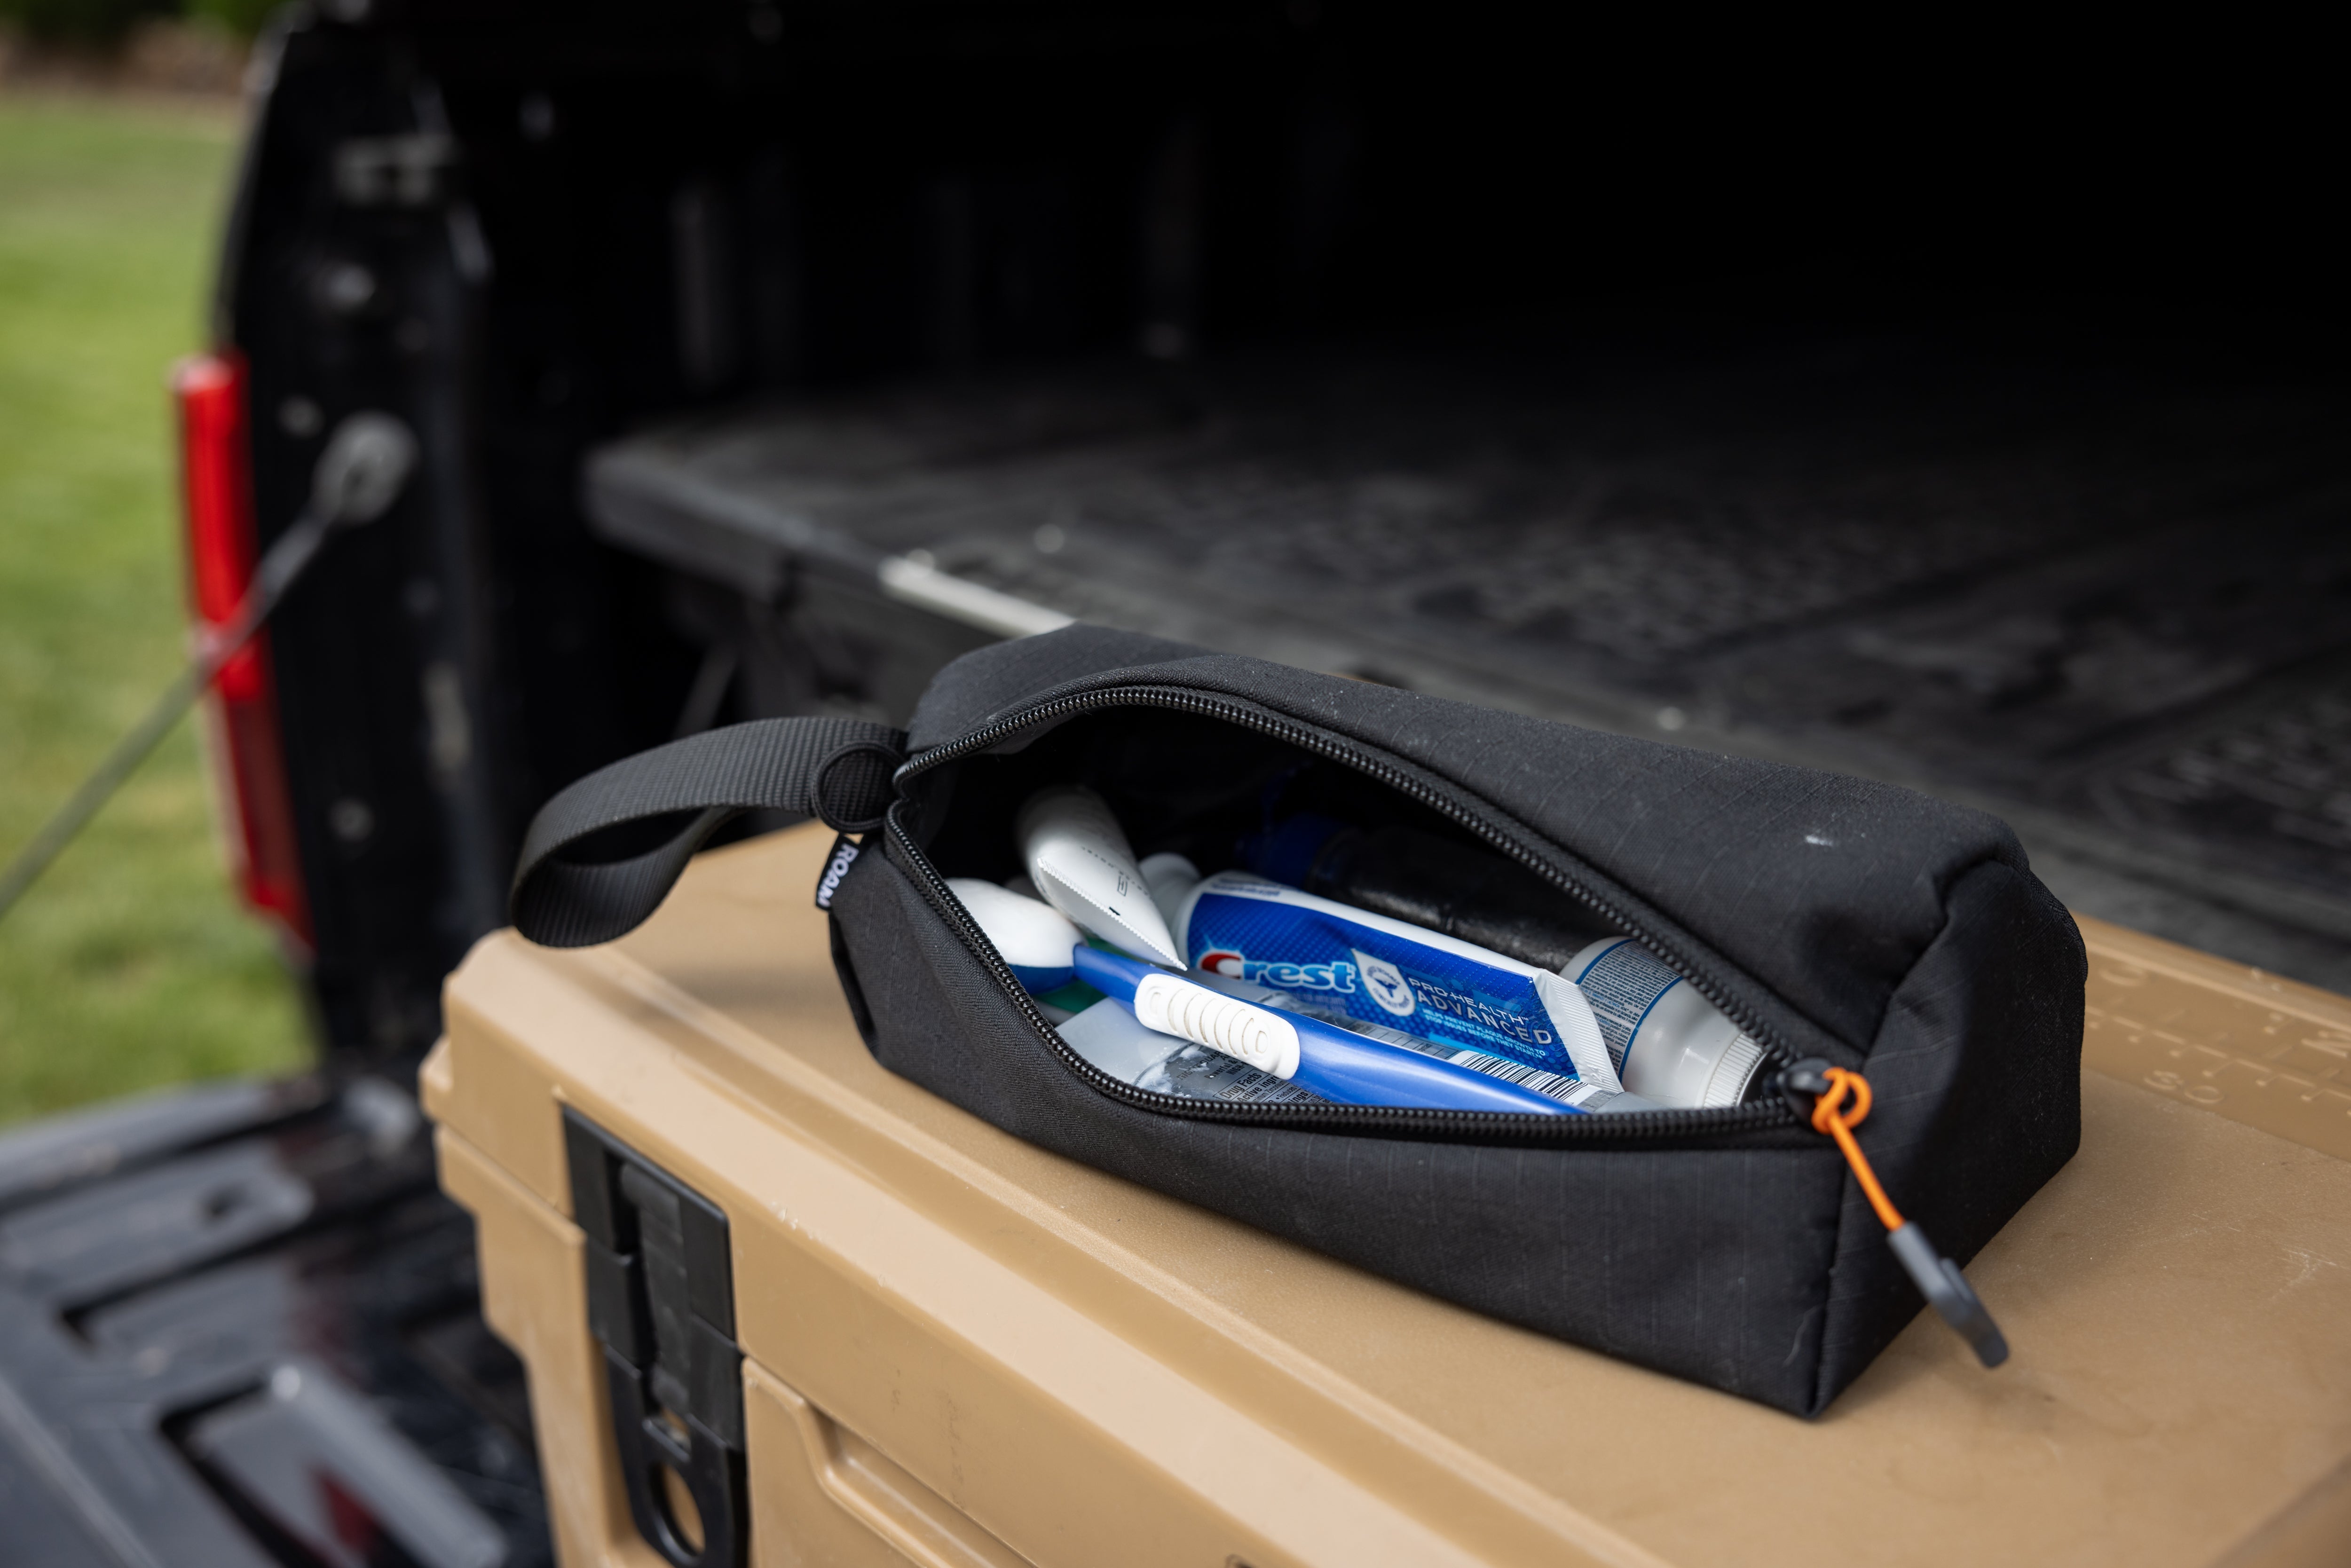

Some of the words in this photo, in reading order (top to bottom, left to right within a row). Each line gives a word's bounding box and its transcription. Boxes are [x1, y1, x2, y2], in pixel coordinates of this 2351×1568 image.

[1417, 990, 1552, 1044] ADVANCED
[1476, 1027, 1504, 1040] PLAQUE
[1504, 1036, 1534, 1053] GROWTH
[1495, 1038, 1514, 1048] THEY
[1199, 1051, 1223, 1065] GUAR
[1219, 1085, 1245, 1099] Drug
[1237, 1073, 1262, 1087] Facts
[1237, 1087, 1262, 1102] Active
[1258, 1075, 1280, 1088] ingre
